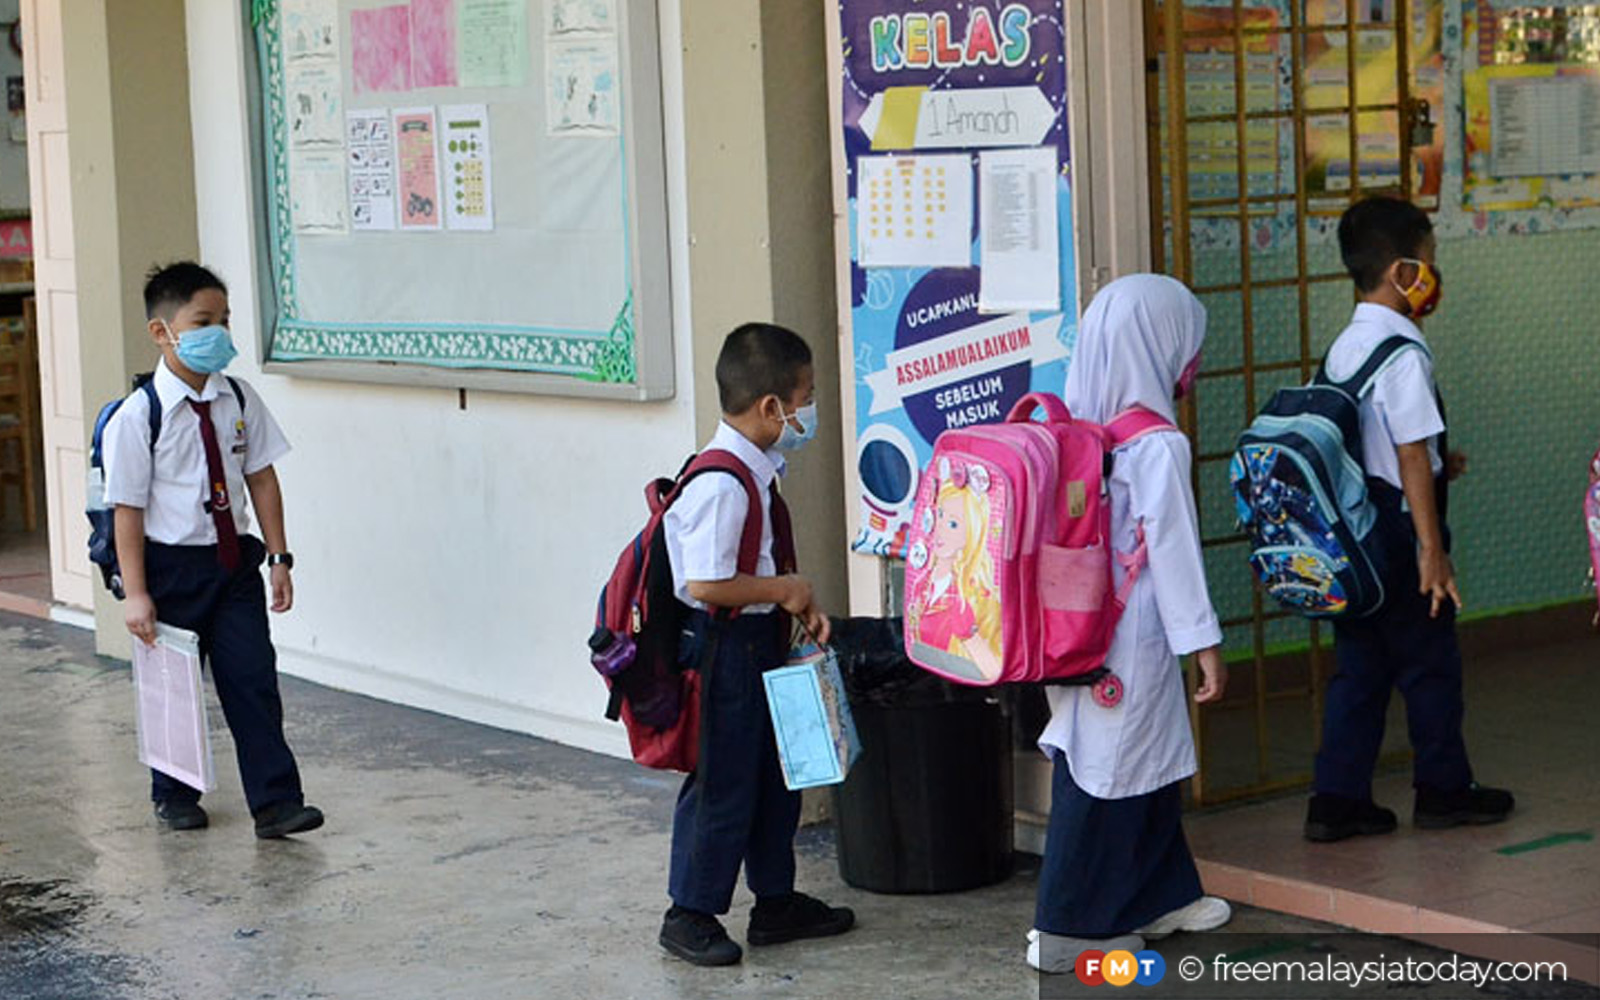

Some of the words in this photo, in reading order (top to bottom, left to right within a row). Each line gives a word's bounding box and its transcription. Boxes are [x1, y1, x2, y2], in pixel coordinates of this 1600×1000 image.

[870, 4, 1031, 72] KELAS
[928, 96, 943, 137] 1
[906, 293, 979, 328] UCAPKANL
[896, 326, 1031, 386] ASSALAMUALAIKUM
[935, 376, 1004, 410] SEBELUM
[946, 400, 1000, 430] MASUK
